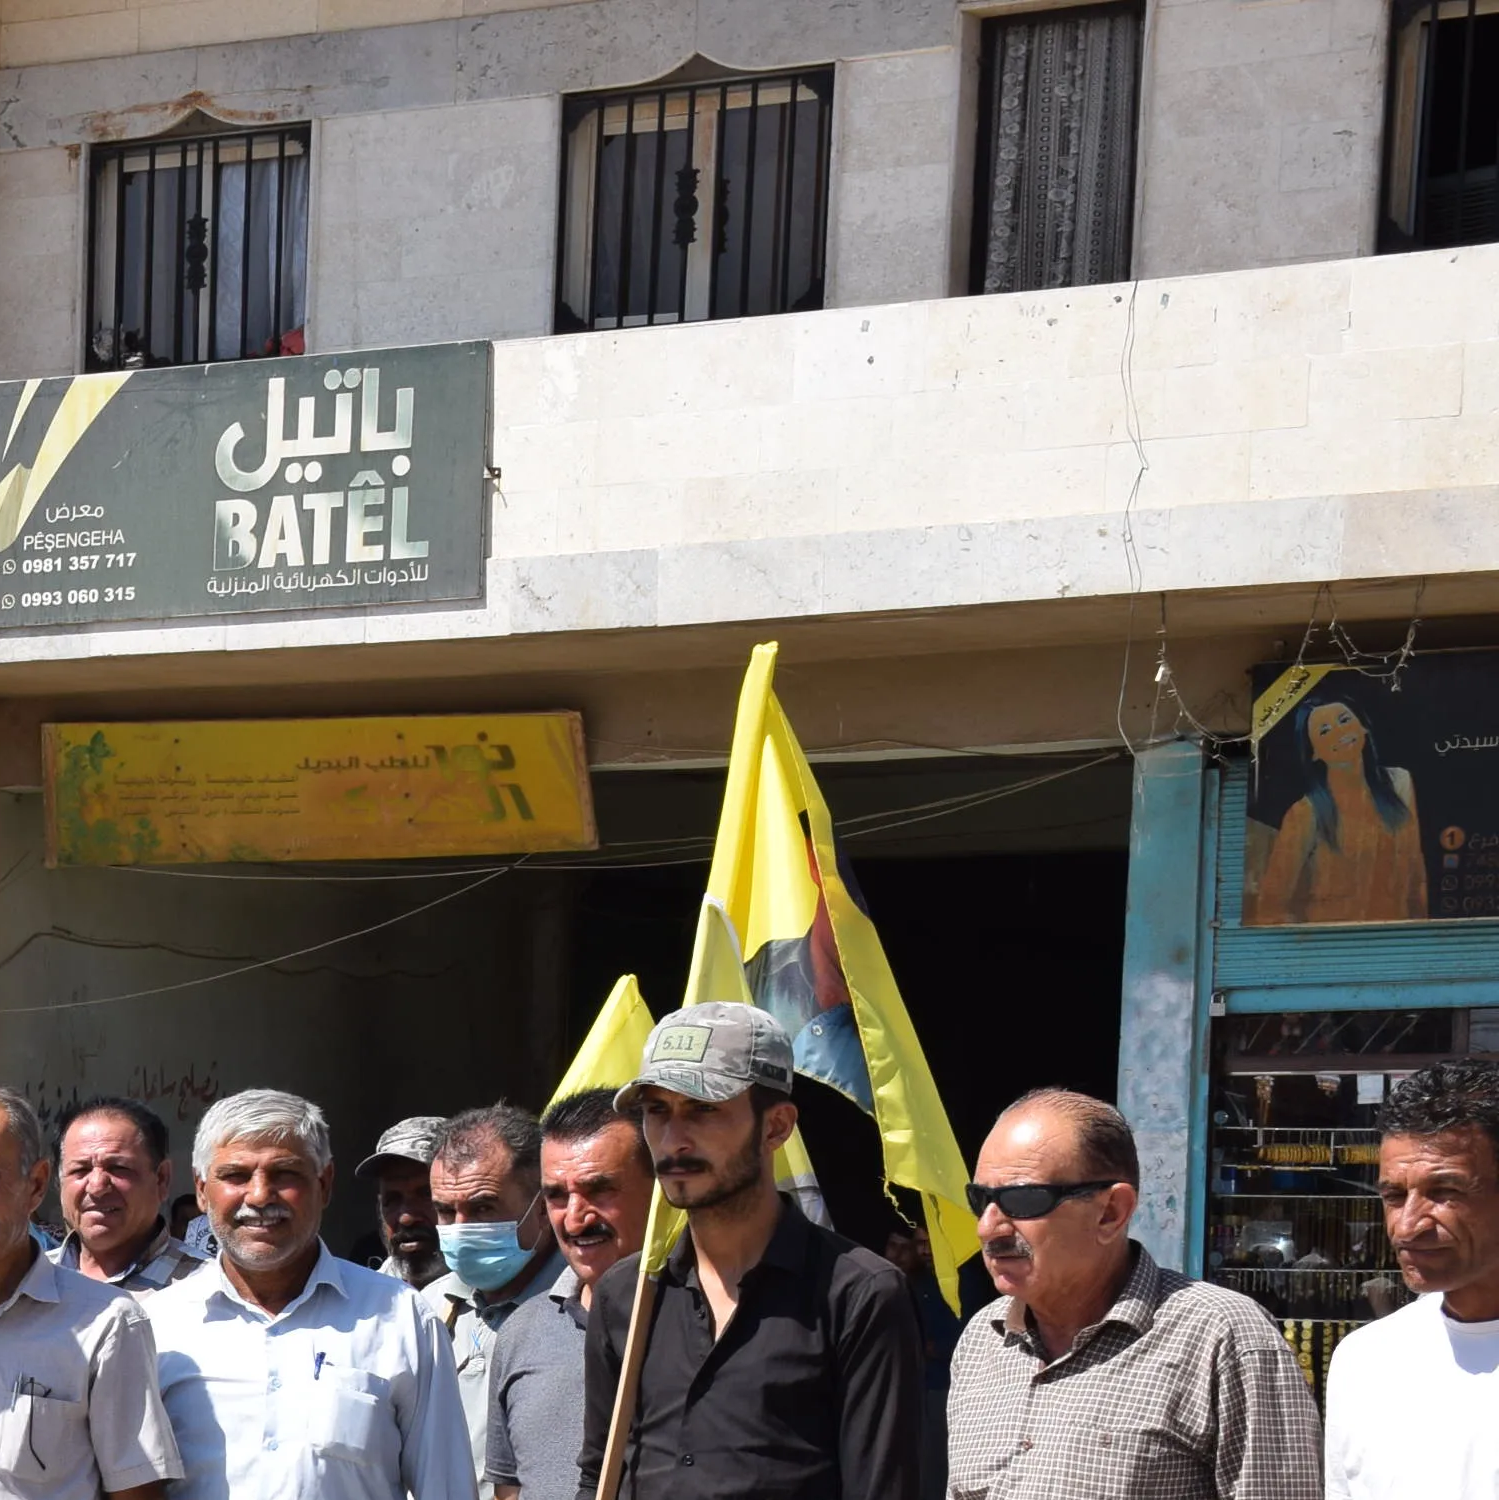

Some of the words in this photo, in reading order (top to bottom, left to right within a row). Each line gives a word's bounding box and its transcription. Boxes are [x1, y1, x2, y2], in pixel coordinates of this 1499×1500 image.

[215, 367, 415, 493] باتيل
[45, 504, 104, 523] معرض
[212, 468, 428, 573] BATÊL
[23, 528, 125, 553] PÊŞENGEHA
[21, 556, 63, 575] 0981
[67, 554, 99, 573] 357
[102, 552, 136, 570] 717
[363, 563, 429, 588] للأدوات
[206, 572, 271, 597] المنزلية
[271, 568, 361, 593] الكهربائية
[21, 590, 63, 608] 0993
[66, 588, 98, 606] 060
[102, 585, 136, 603] 315
[296, 755, 360, 774] البديل
[364, 754, 430, 773] للطب
[662, 1035, 696, 1052] 5.11
[127, 1063, 178, 1104] ساعات
[177, 1060, 221, 1122] تصليح
